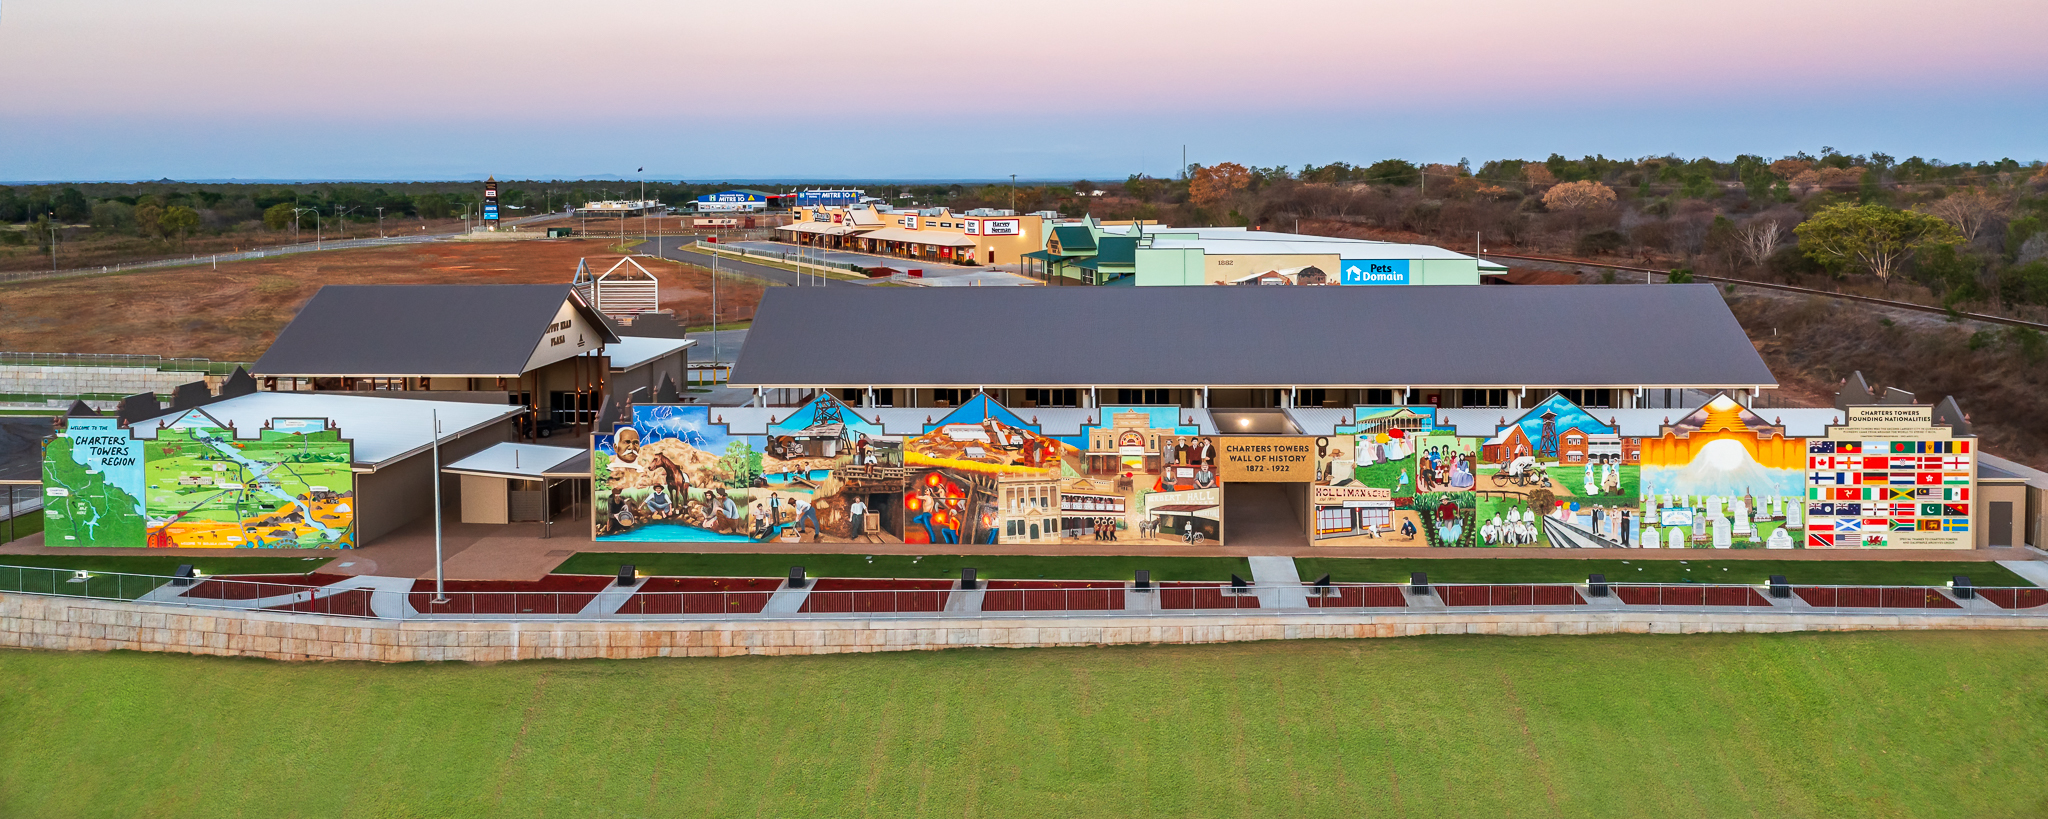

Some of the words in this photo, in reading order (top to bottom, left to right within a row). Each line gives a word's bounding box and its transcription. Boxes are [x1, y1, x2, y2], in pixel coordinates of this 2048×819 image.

[1370, 263, 1392, 273] Pets
[1362, 270, 1404, 282] Domain
[75, 435, 127, 446] CHARTERS
[90, 446, 129, 456] TOWERS
[1226, 445, 1272, 453] CHARTERS
[1273, 445, 1310, 453] TOWERS
[101, 457, 136, 467] REGION
[1187, 491, 1215, 501] HALL
[1315, 487, 1367, 497] HOLLIMAN
